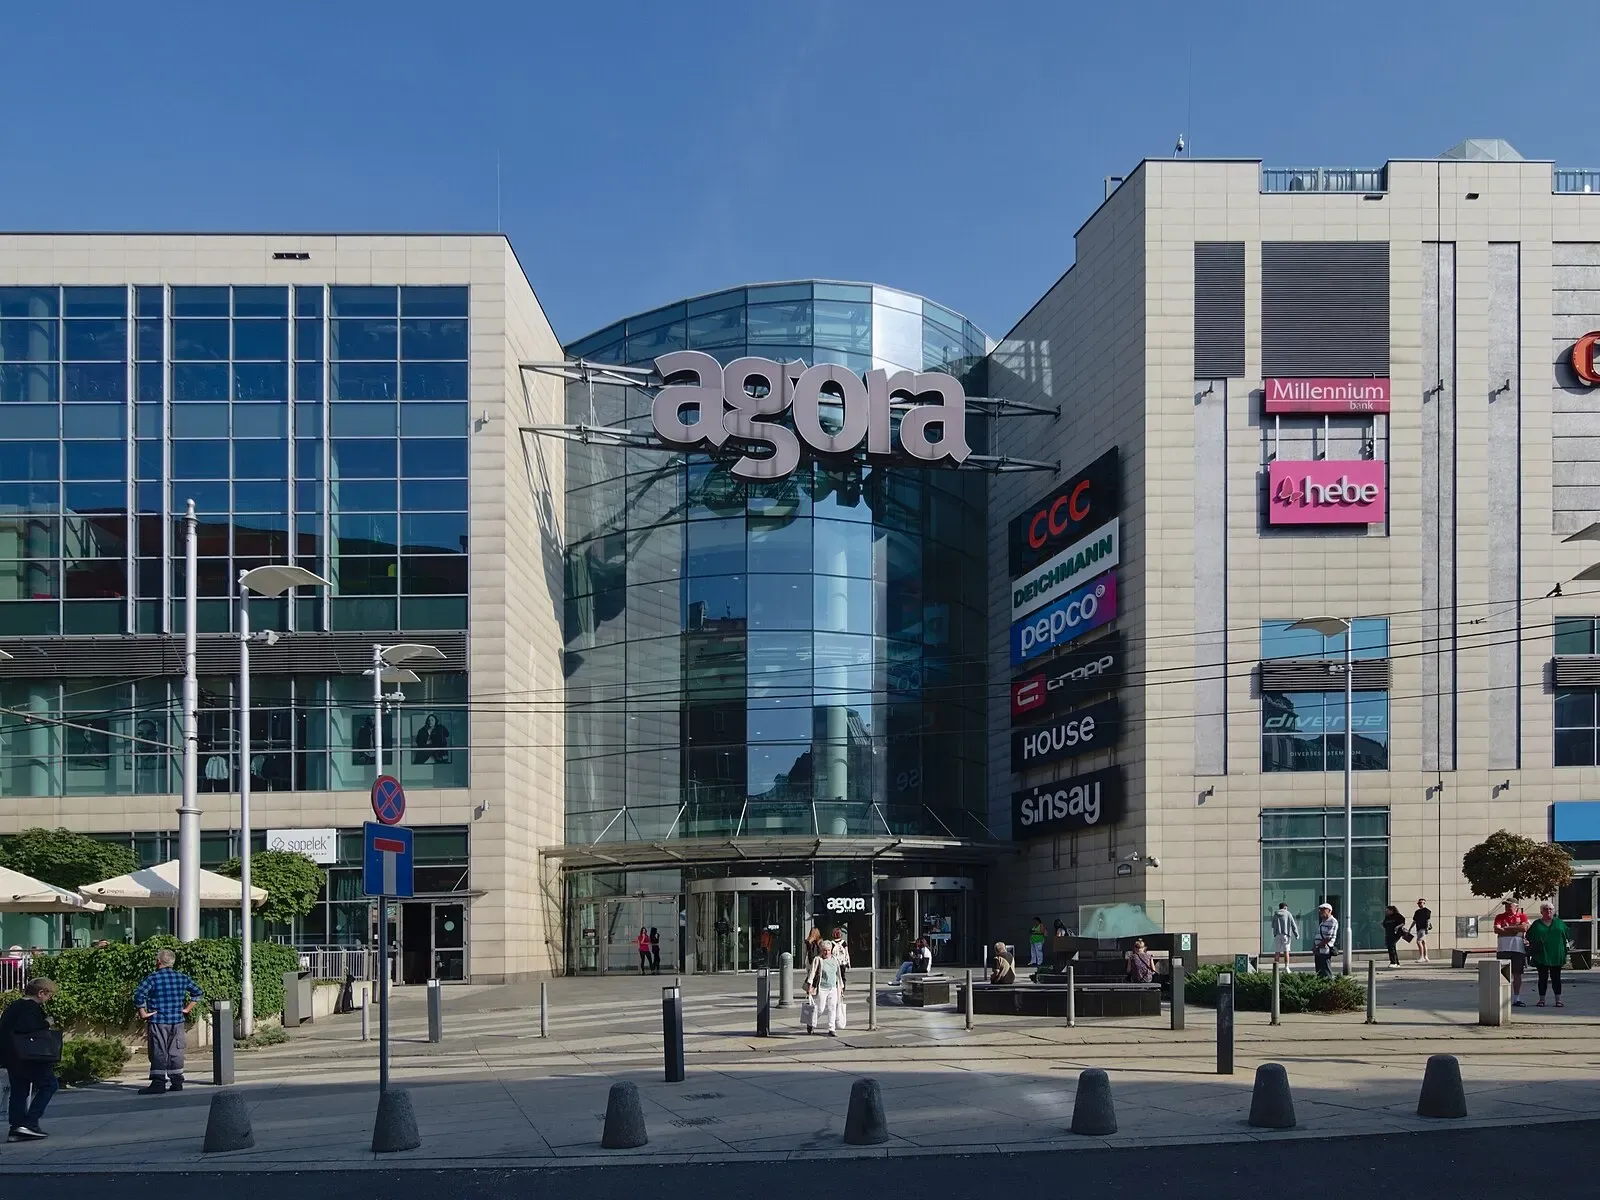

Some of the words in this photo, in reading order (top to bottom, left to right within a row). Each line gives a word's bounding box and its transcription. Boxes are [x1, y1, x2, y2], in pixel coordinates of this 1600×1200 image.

[1273, 379, 1384, 399] Millennium
[652, 351, 972, 479] agora
[1350, 401, 1373, 410] bank
[1305, 475, 1379, 504] hebe
[1028, 480, 1090, 549] CCC
[1014, 534, 1113, 608] DEICHMANN
[1047, 655, 1114, 691] cropp
[1264, 713, 1385, 728] diverse
[1020, 781, 1100, 826] sinsay
[287, 836, 328, 853] sopelek
[826, 897, 866, 914] agora
